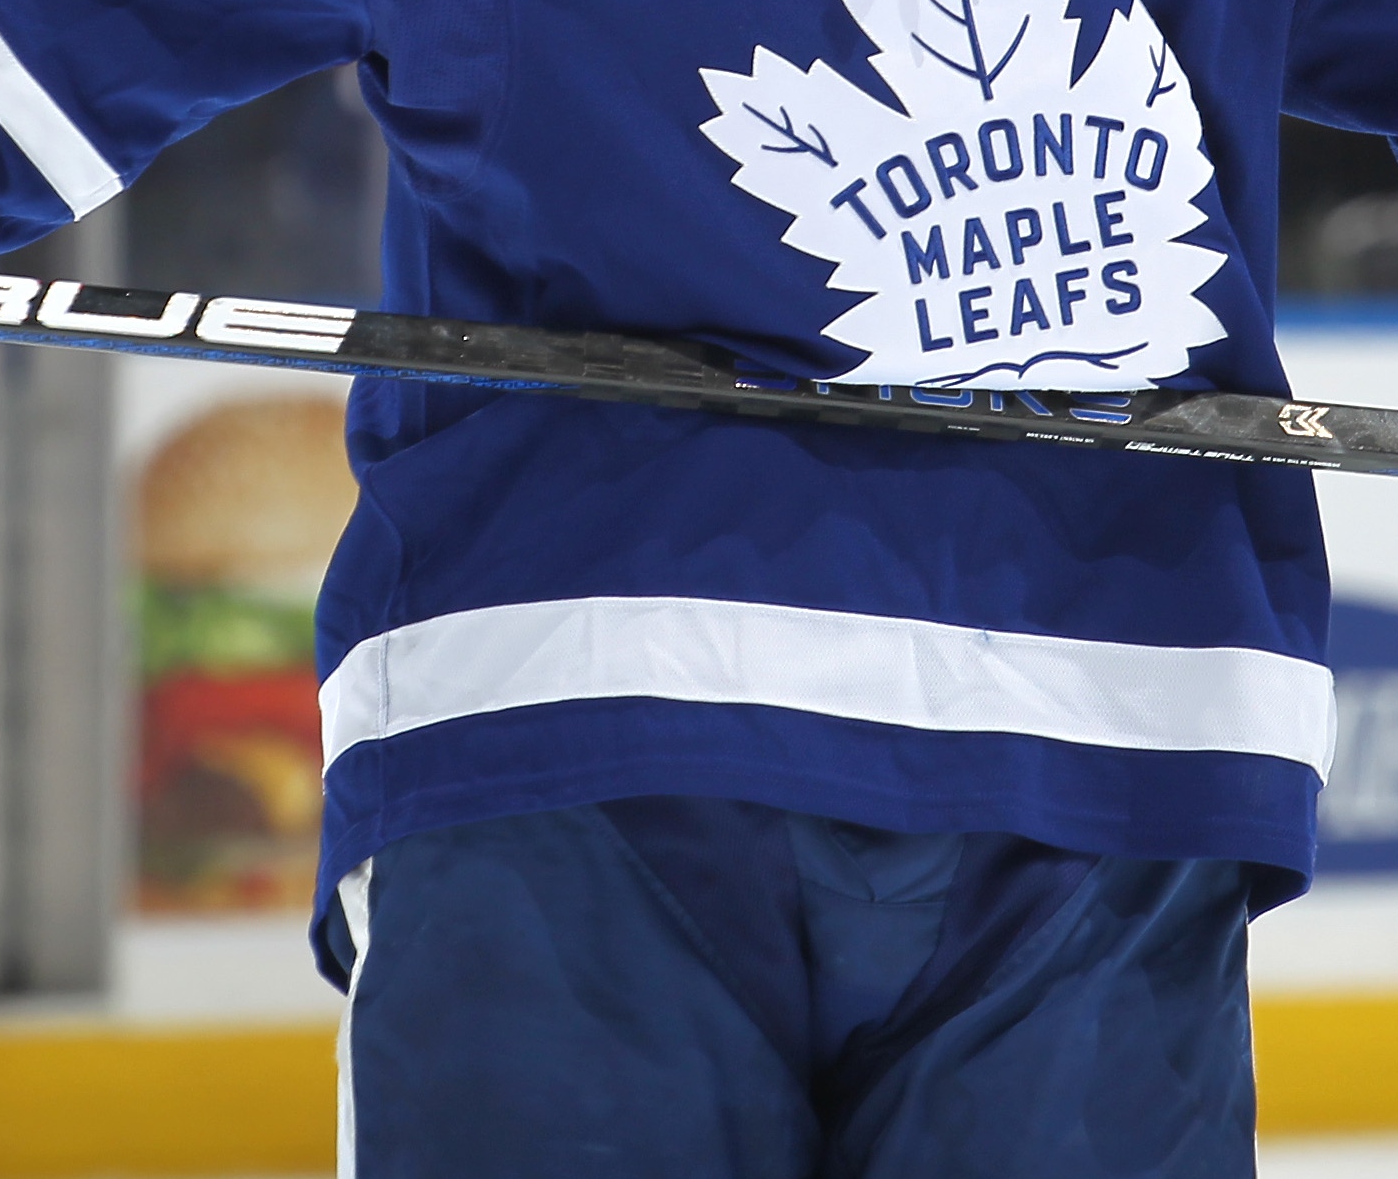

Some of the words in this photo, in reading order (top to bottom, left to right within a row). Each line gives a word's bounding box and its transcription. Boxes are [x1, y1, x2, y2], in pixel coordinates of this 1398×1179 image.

[831, 112, 1168, 240] TORONTO
[901, 190, 1133, 284] MAPLE
[916, 259, 1142, 353] LEAFS
